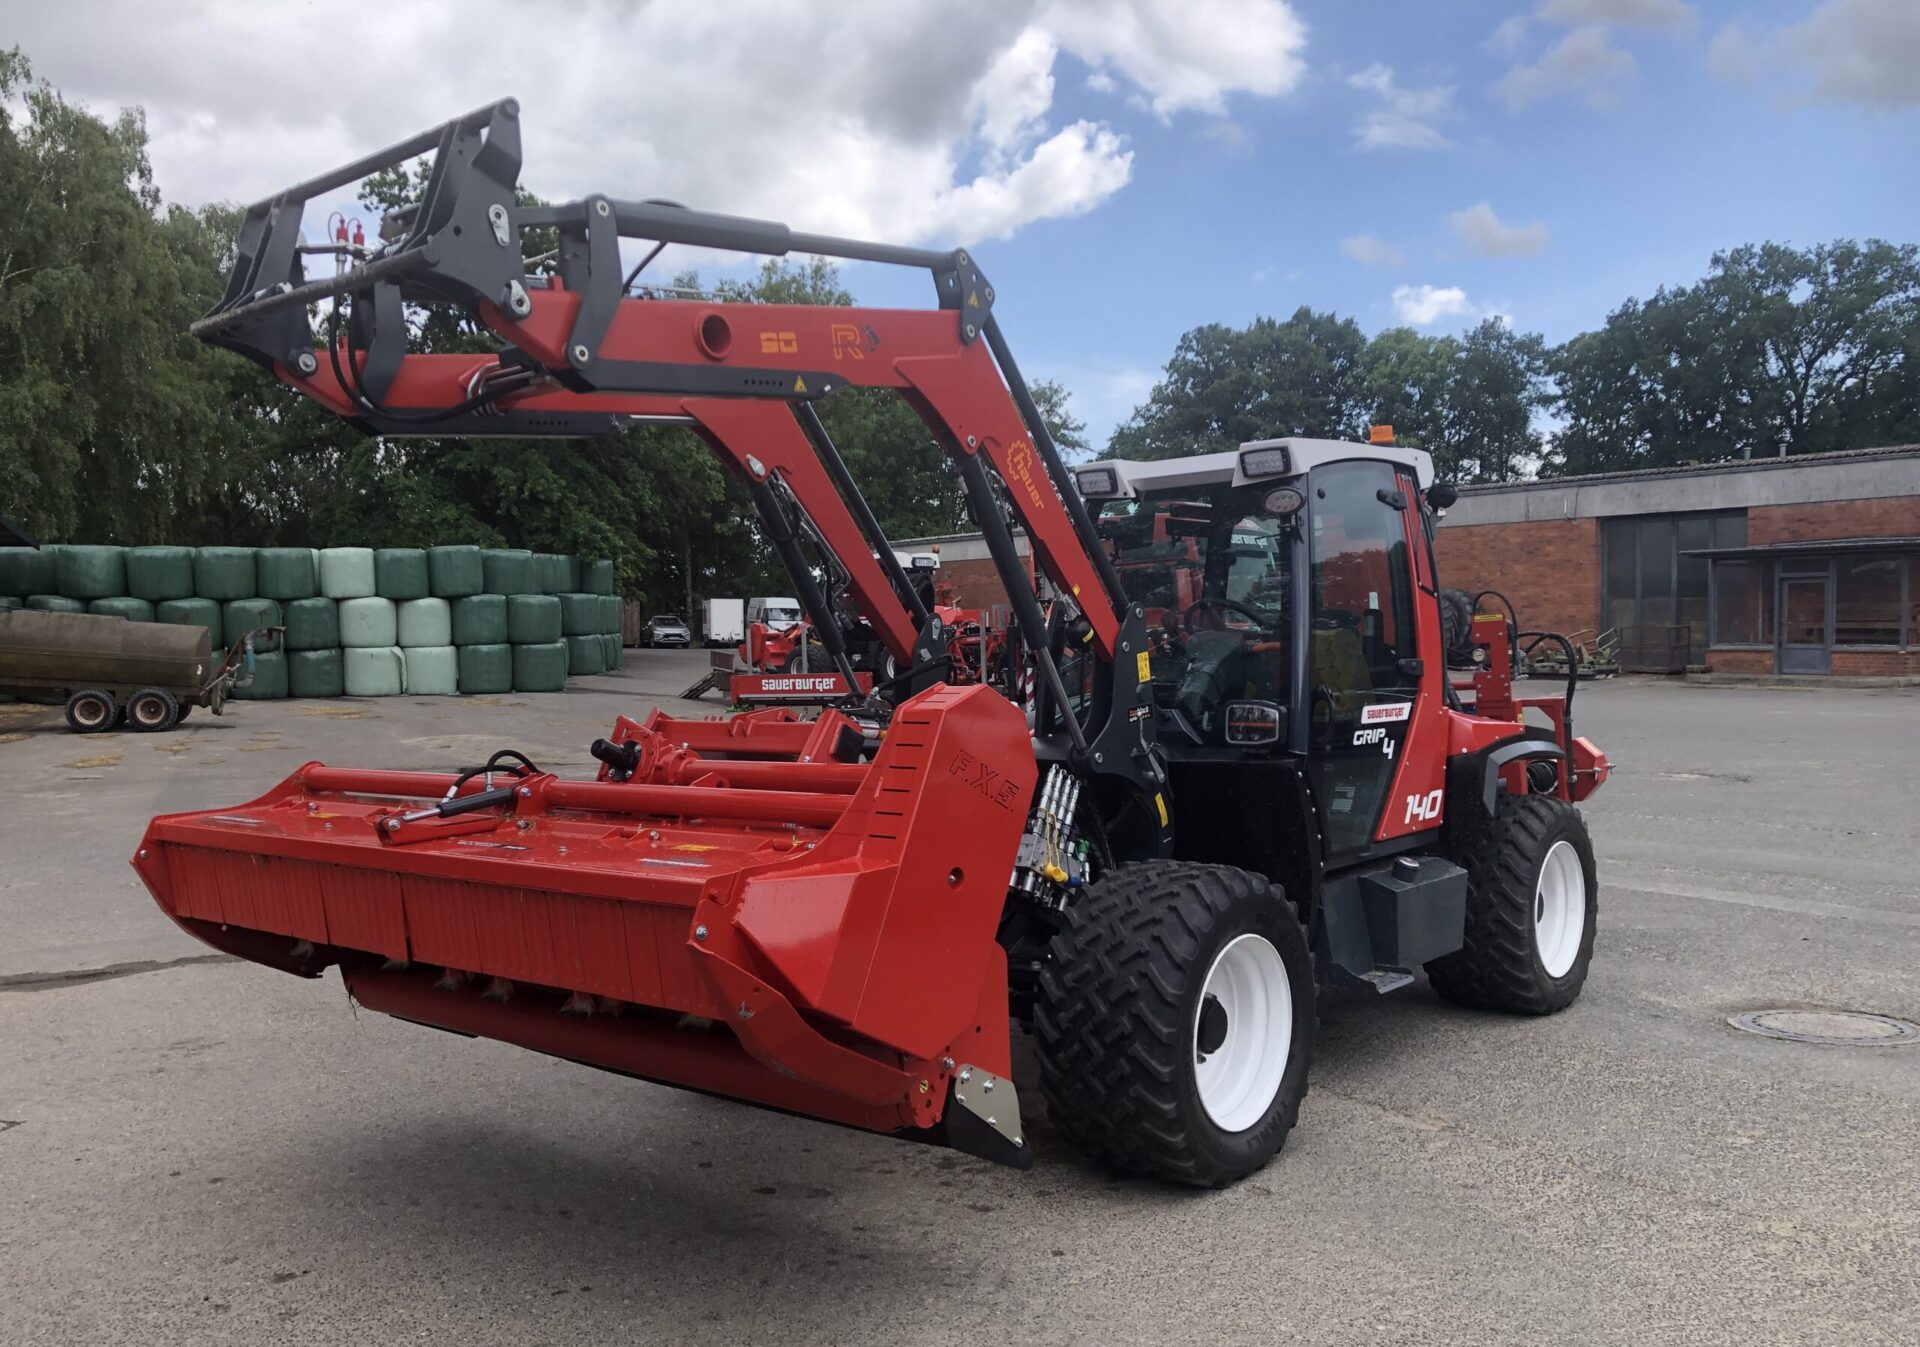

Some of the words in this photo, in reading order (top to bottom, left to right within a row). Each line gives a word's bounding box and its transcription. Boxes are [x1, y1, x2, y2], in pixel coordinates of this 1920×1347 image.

[1013, 452, 1045, 509] hauer
[1353, 728, 1386, 746] GRIP
[1382, 737, 1395, 760] 4
[1404, 789, 1443, 824] 140
